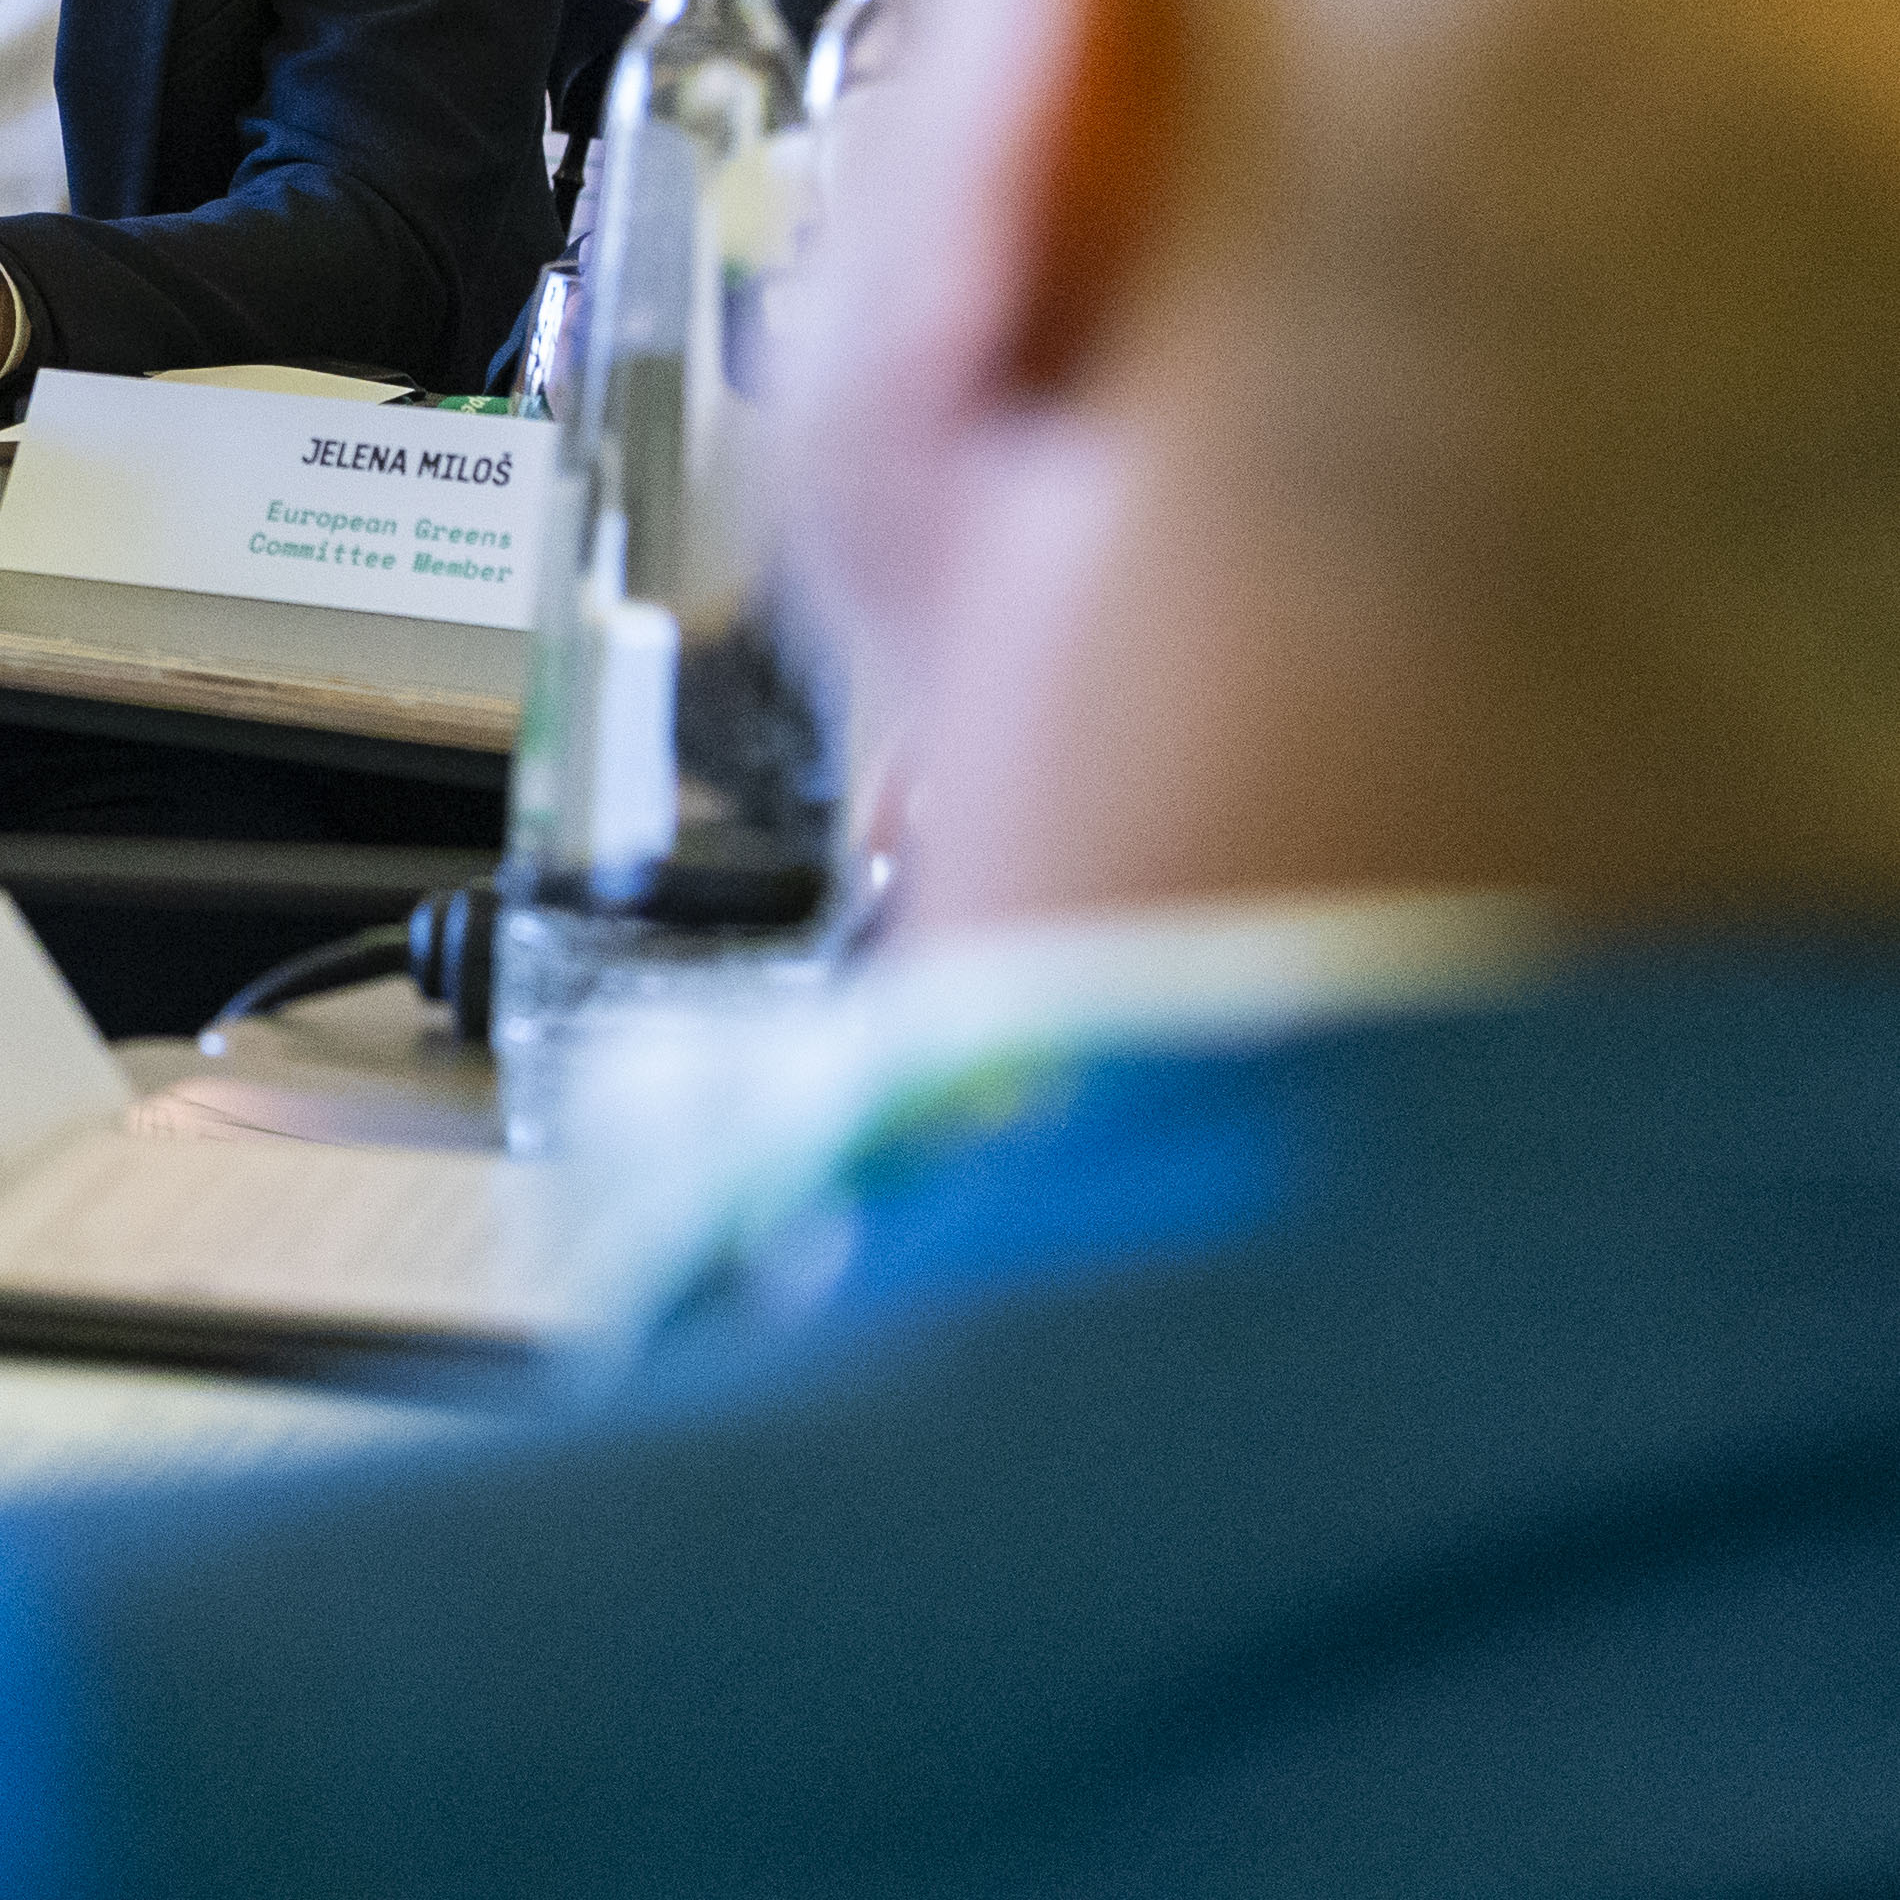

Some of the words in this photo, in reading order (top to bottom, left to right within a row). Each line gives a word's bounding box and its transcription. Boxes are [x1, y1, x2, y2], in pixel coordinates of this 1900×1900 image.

[301, 437, 406, 476] JELENA
[416, 451, 513, 487] MILOŠ
[266, 499, 398, 536] European
[413, 517, 513, 550] Greens
[248, 531, 395, 571] Committee
[412, 551, 513, 583] Member
